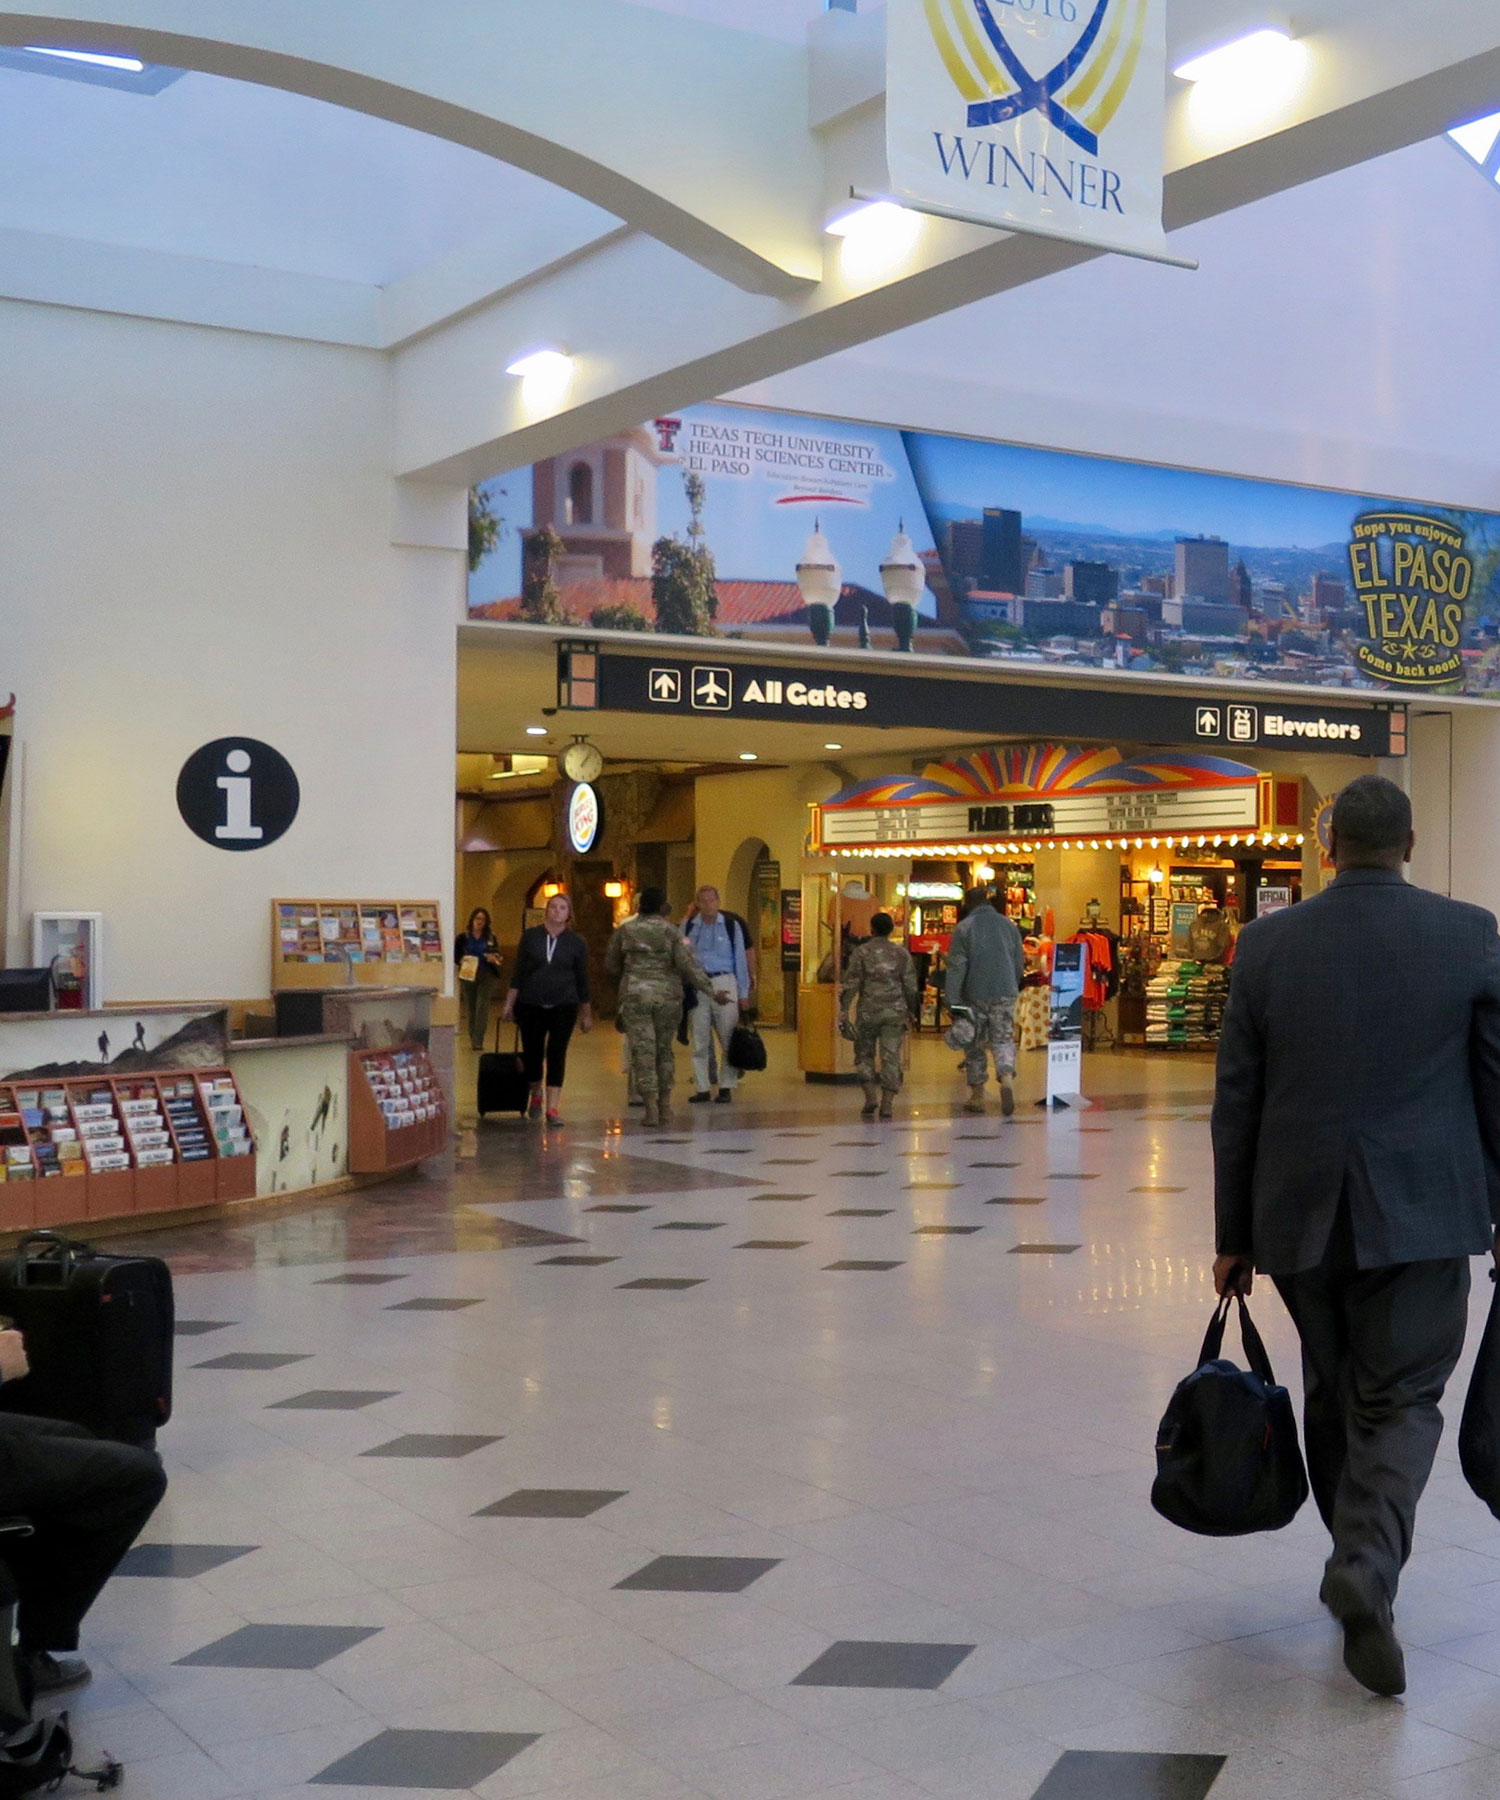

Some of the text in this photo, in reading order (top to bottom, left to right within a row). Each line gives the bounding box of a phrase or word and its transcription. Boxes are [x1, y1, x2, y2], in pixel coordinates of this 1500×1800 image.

[933, 131, 1125, 215] WINNER
[690, 423, 875, 459] TEXAS TECH UNIVERSITY
[689, 440, 884, 477] HEALTH SCIENCES CENTER
[689, 456, 750, 476] EL PASO
[1353, 522, 1462, 549] Hope you enjoyed
[1350, 542, 1471, 600] EL PASO
[1359, 593, 1462, 648] TEXAS
[1359, 646, 1461, 677] Come back soon!
[742, 680, 868, 710] All Gates
[1263, 715, 1362, 741] Elevators
